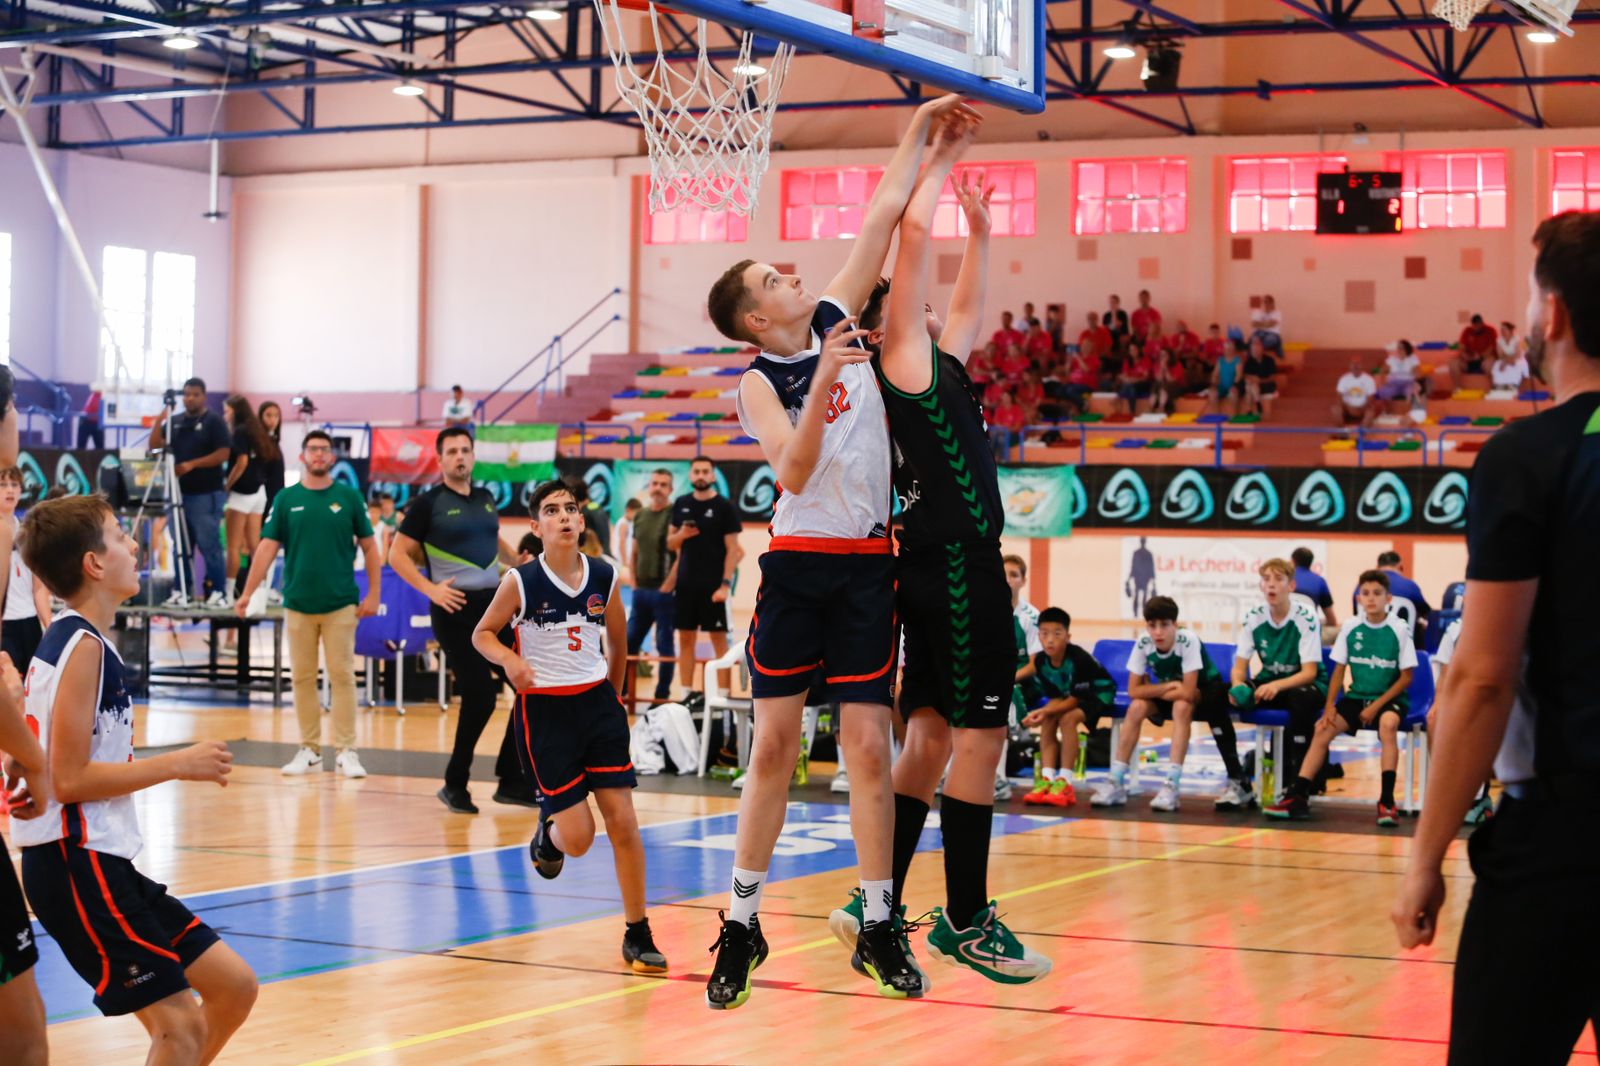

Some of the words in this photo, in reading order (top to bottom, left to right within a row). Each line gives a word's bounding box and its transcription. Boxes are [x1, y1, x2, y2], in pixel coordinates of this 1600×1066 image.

[1389, 199, 1399, 214] 2
[1157, 557, 1175, 572] La
[567, 626, 581, 651] 5
